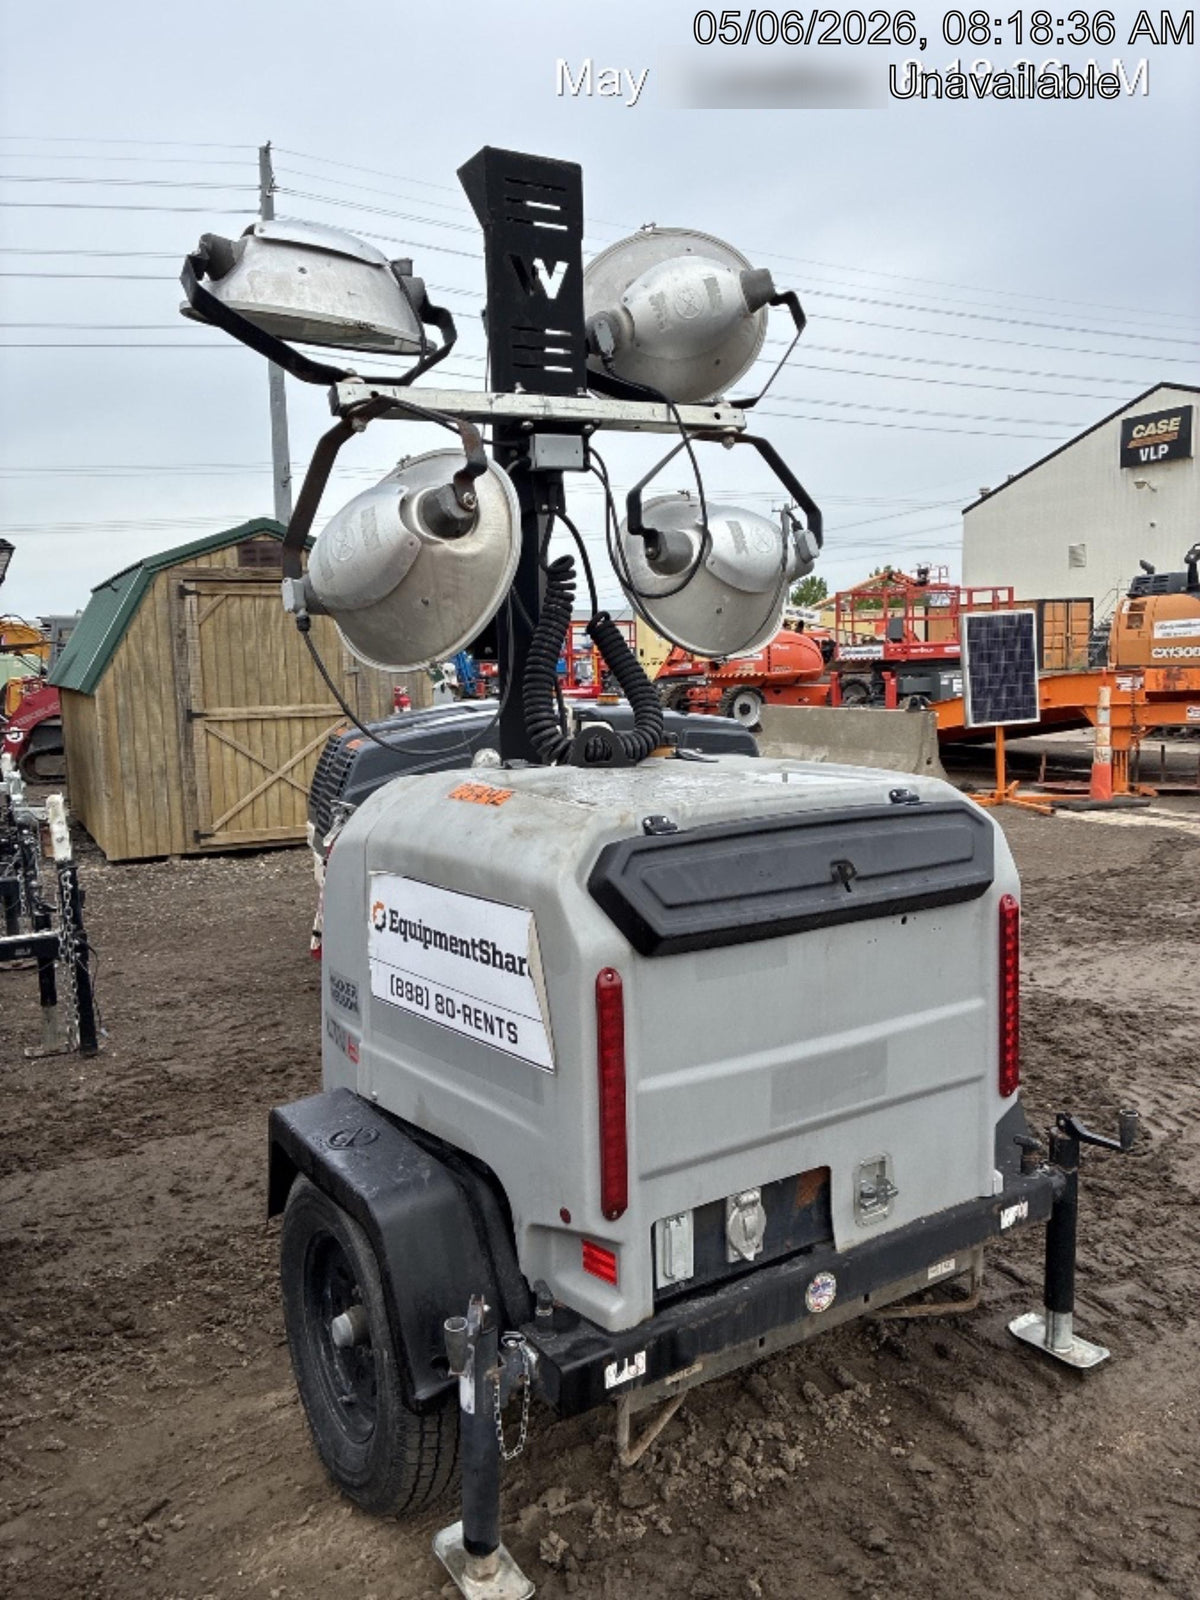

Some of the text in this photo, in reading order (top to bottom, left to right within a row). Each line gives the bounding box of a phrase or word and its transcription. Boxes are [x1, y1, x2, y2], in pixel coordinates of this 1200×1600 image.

[1132, 416, 1181, 438] CASE
[1139, 444, 1169, 462] VLP
[389, 908, 533, 977] EquipmentShar
[390, 973, 430, 1010] (888)
[434, 993, 519, 1045] 80-RENTS
